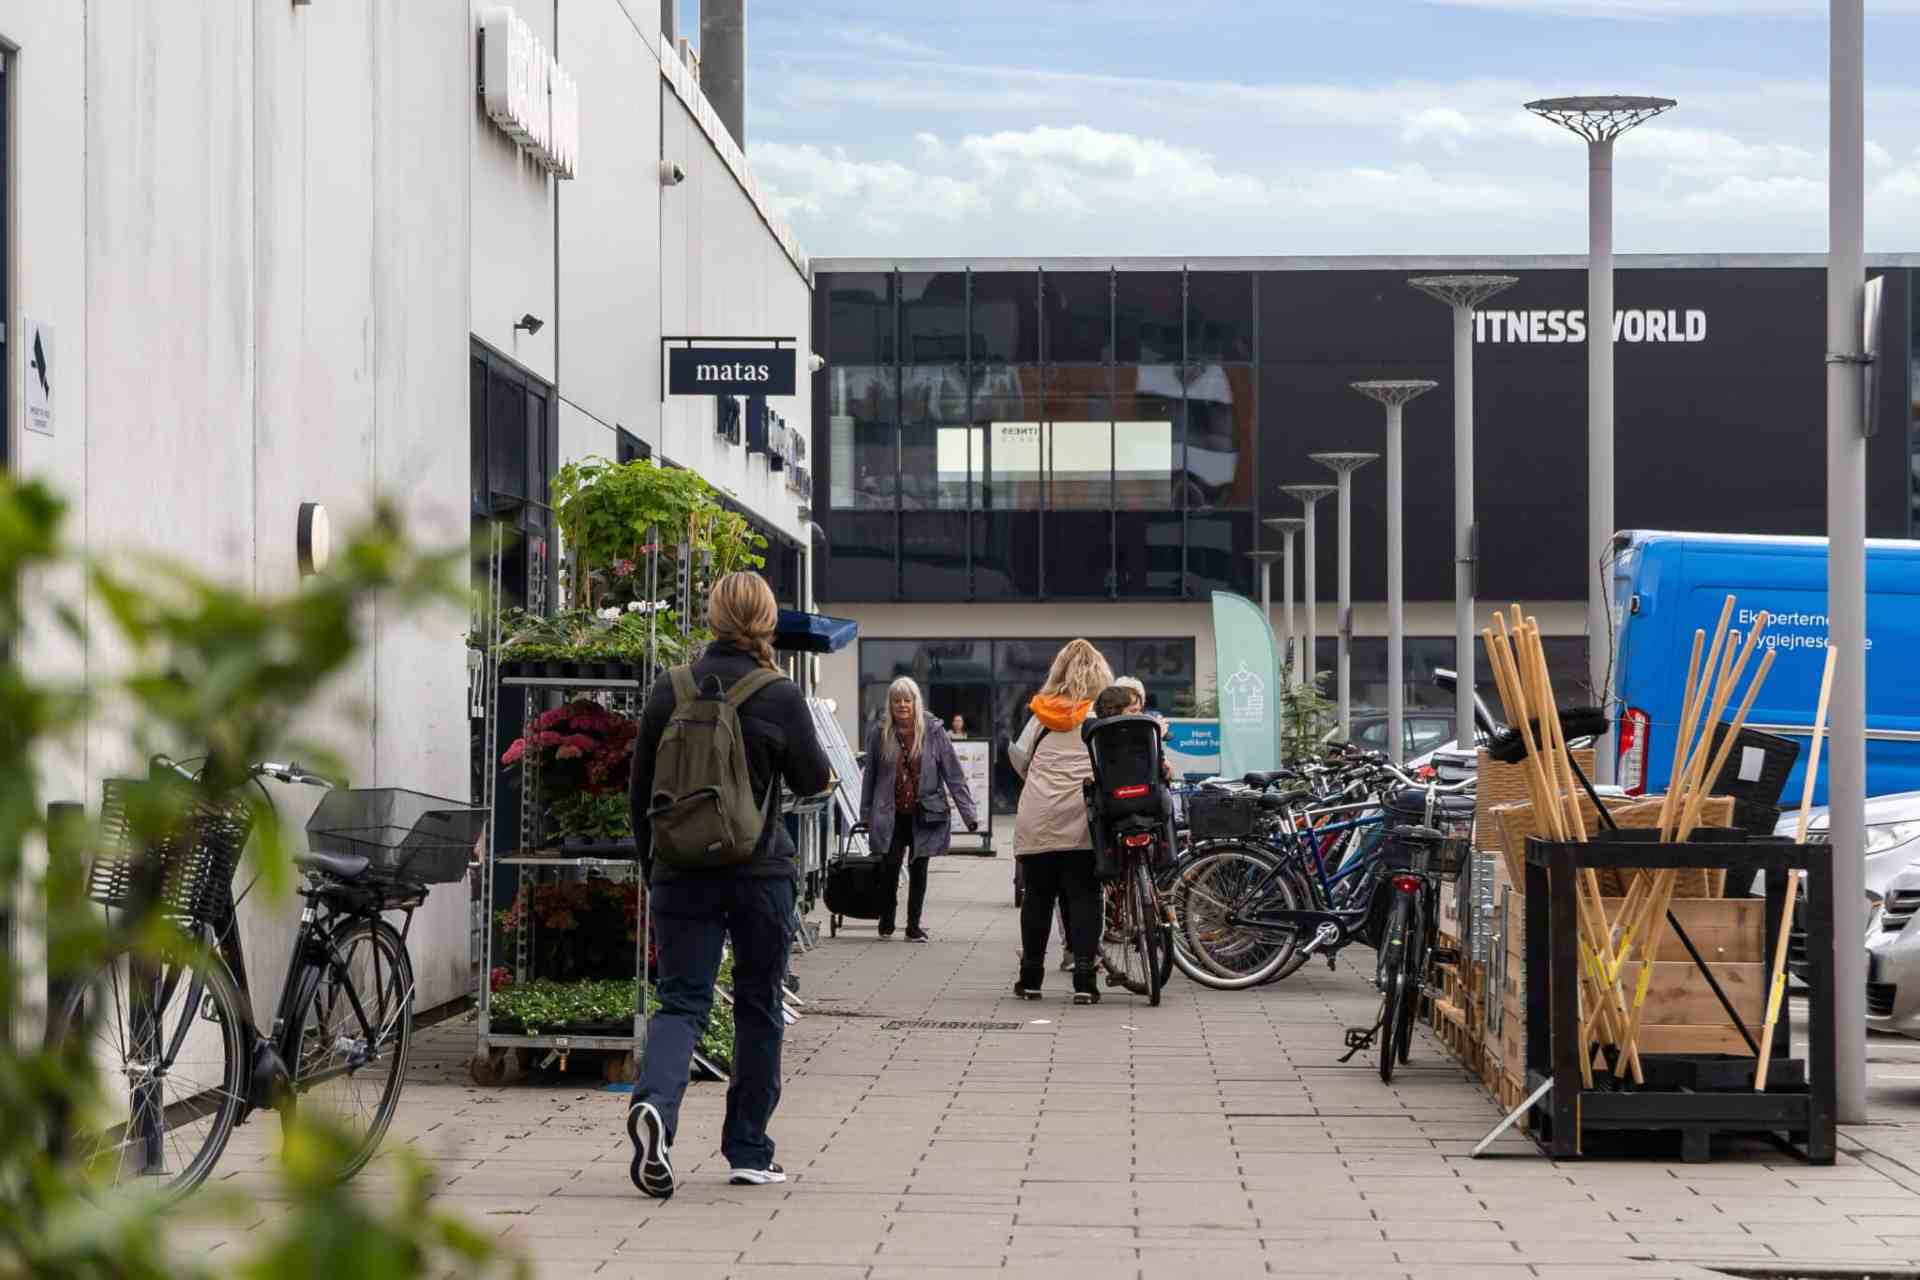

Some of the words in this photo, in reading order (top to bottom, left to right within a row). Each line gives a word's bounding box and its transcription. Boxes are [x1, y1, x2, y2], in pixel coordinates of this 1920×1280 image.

[1472, 310, 1586, 343] ITNESS
[695, 362, 769, 381] matas
[1739, 609, 1830, 627] Ekpertern
